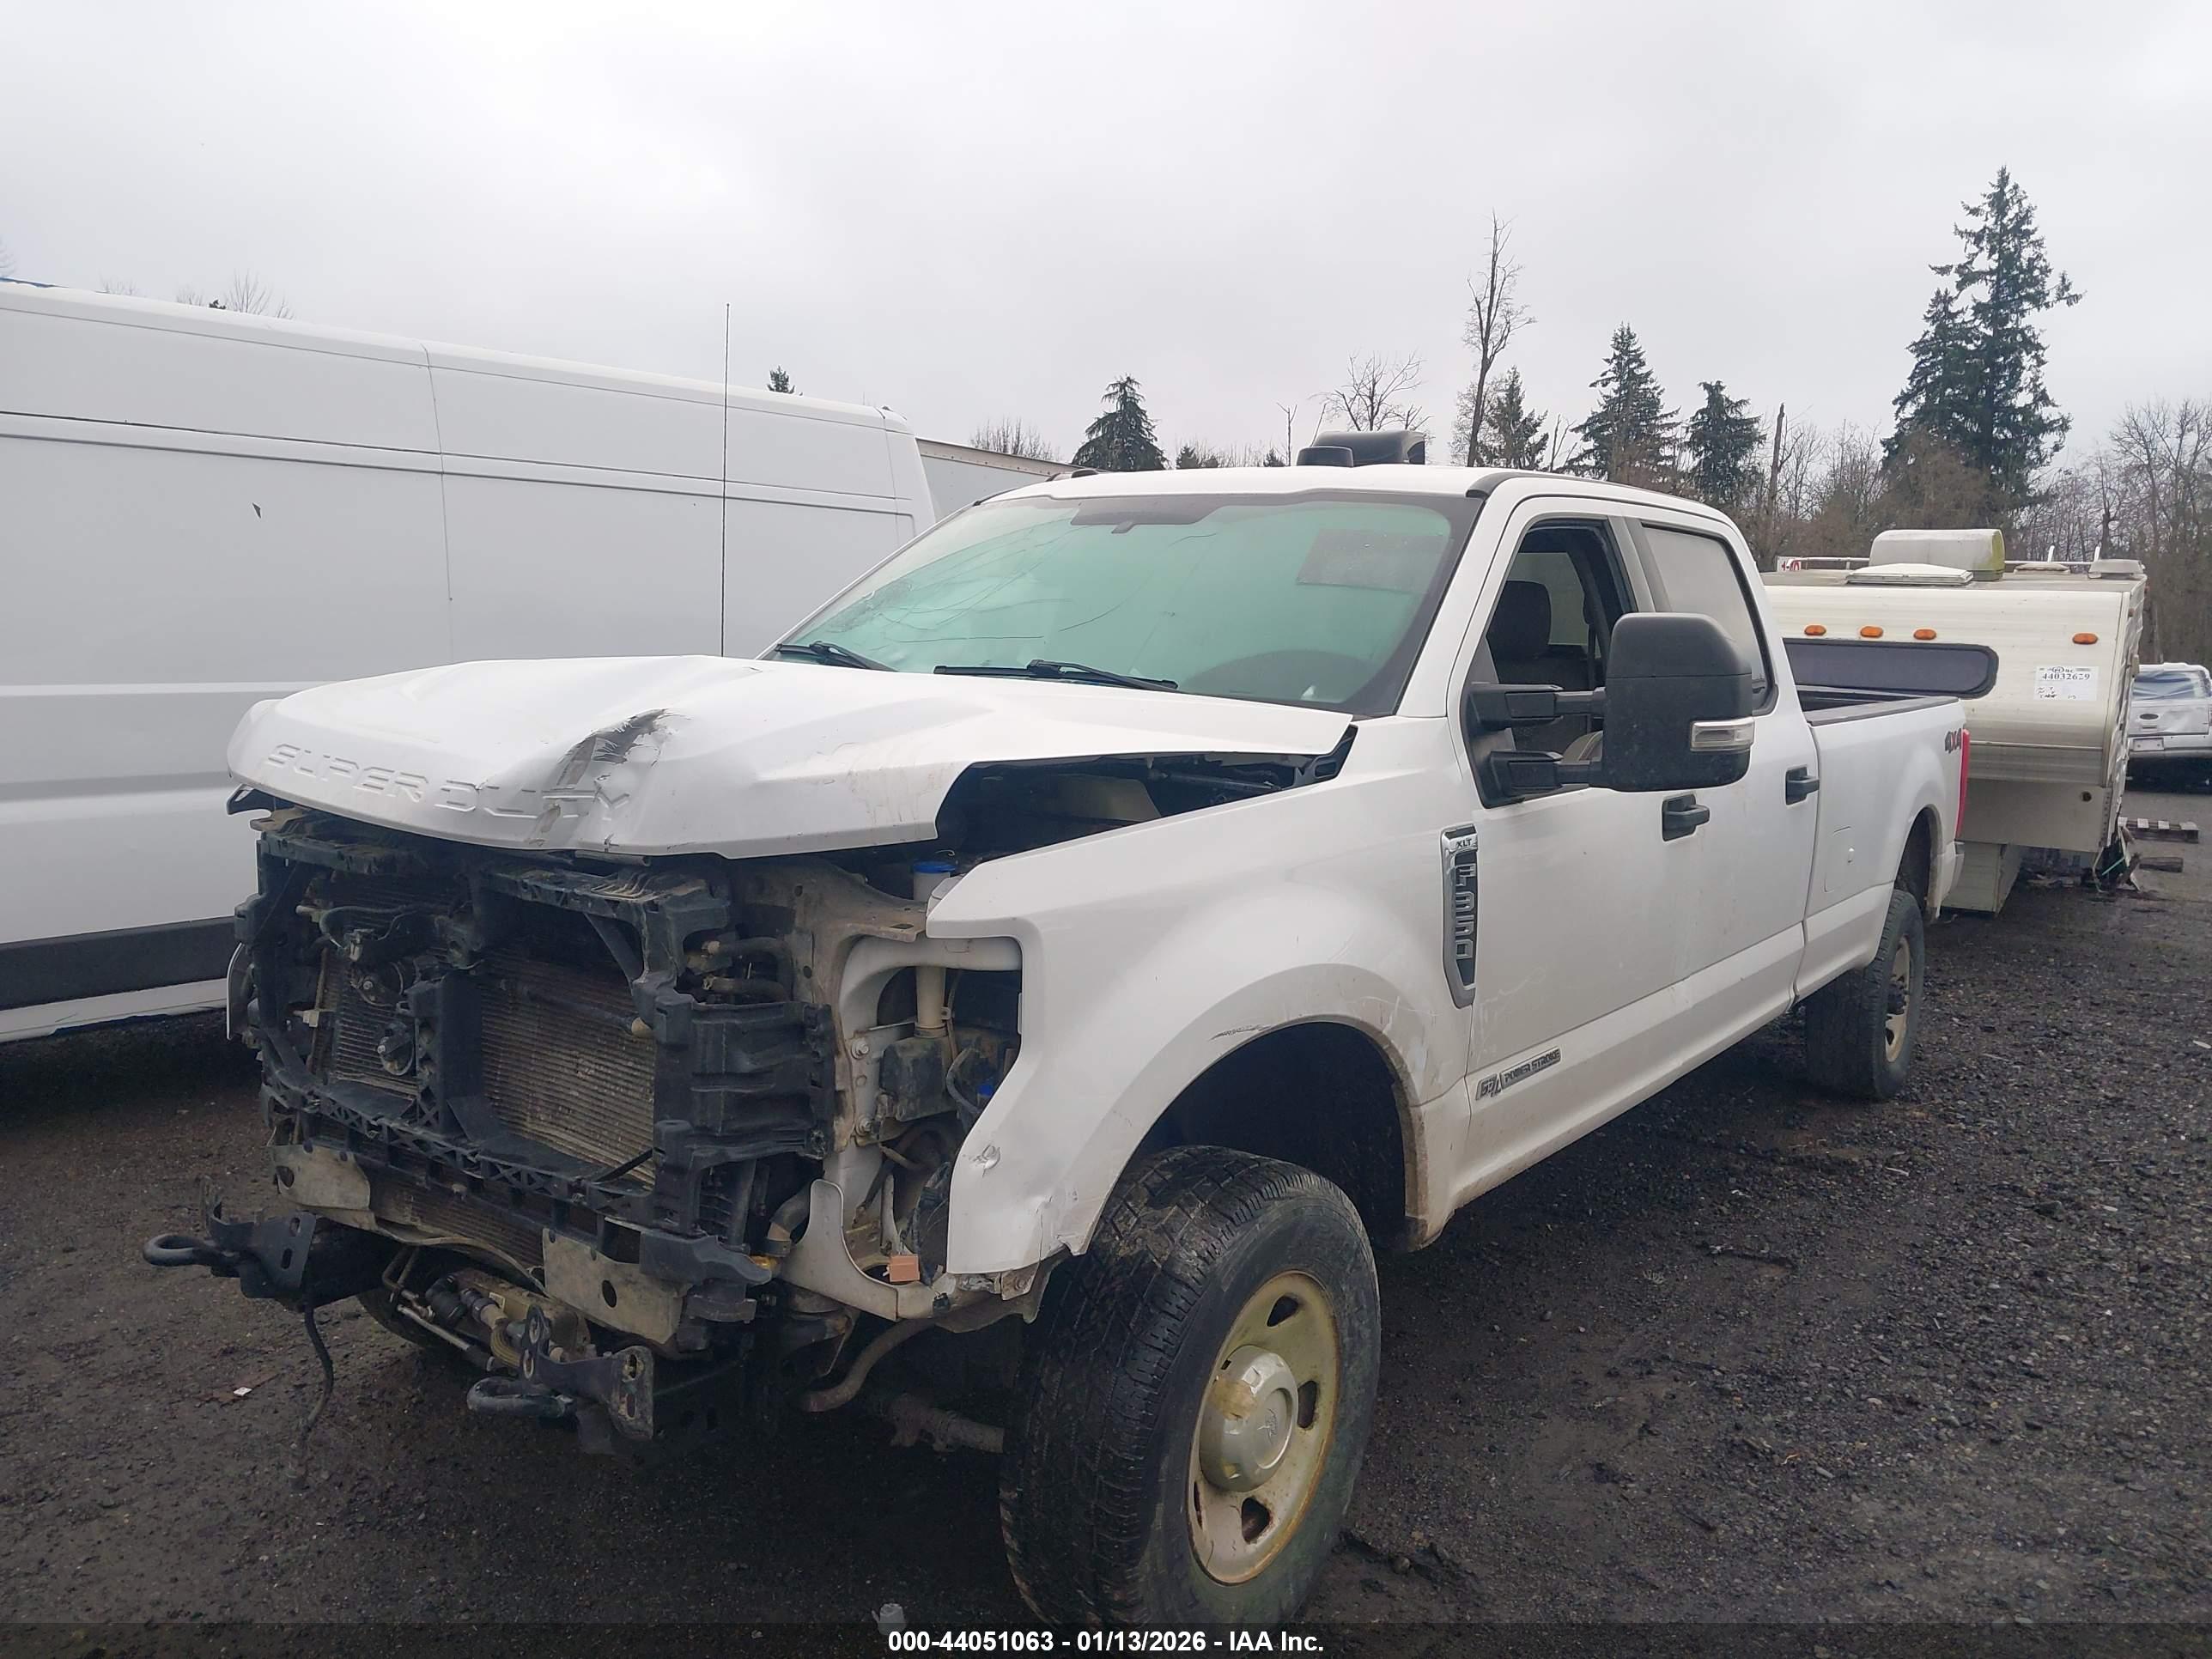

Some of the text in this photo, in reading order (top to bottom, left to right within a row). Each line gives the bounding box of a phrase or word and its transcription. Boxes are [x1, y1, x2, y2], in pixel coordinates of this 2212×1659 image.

[262, 743, 429, 804] SUPER
[1456, 838, 1473, 849] XLT
[1504, 1063, 1531, 1083] POWER
[1531, 1048, 1561, 1073] STROKE
